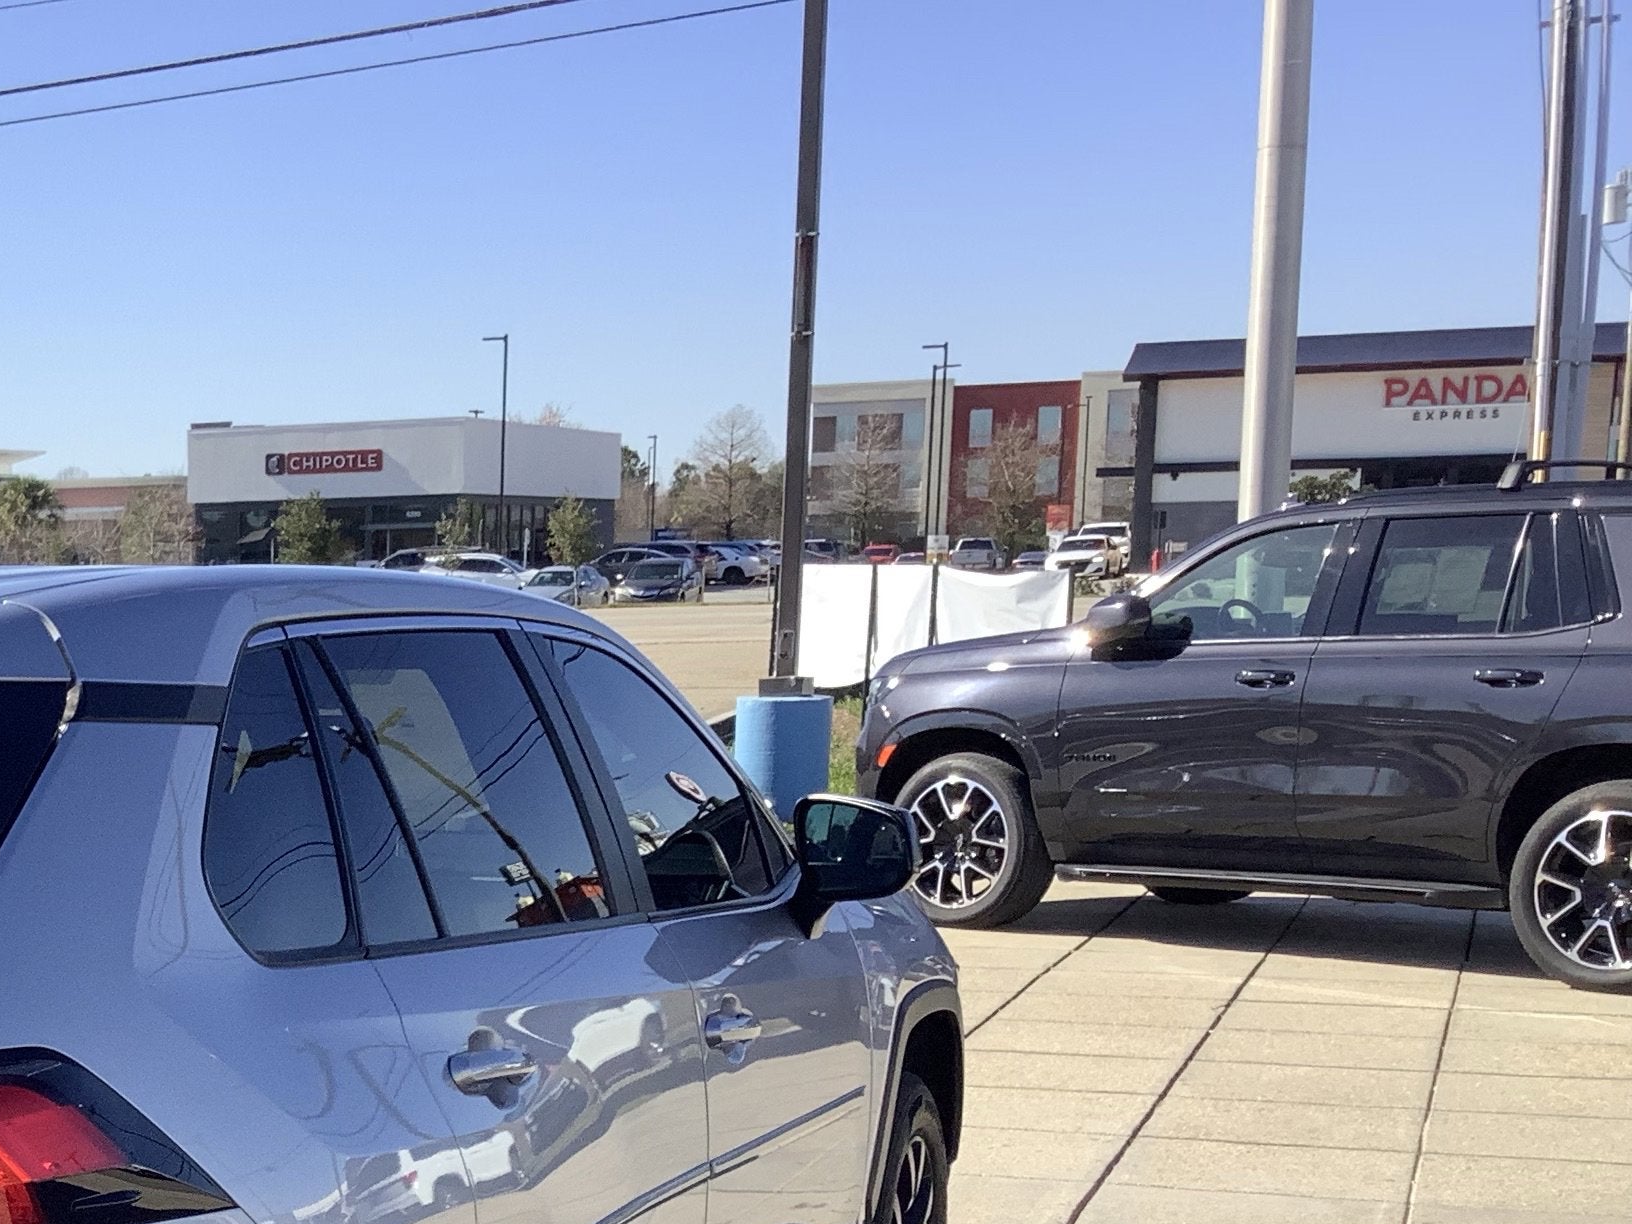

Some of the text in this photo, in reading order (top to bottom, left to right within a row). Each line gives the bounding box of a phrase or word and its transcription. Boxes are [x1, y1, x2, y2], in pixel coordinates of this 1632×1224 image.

[1383, 373, 1531, 407] PANDA
[1412, 408, 1500, 421] EXPRESS
[289, 453, 378, 470] CHIPOTLE
